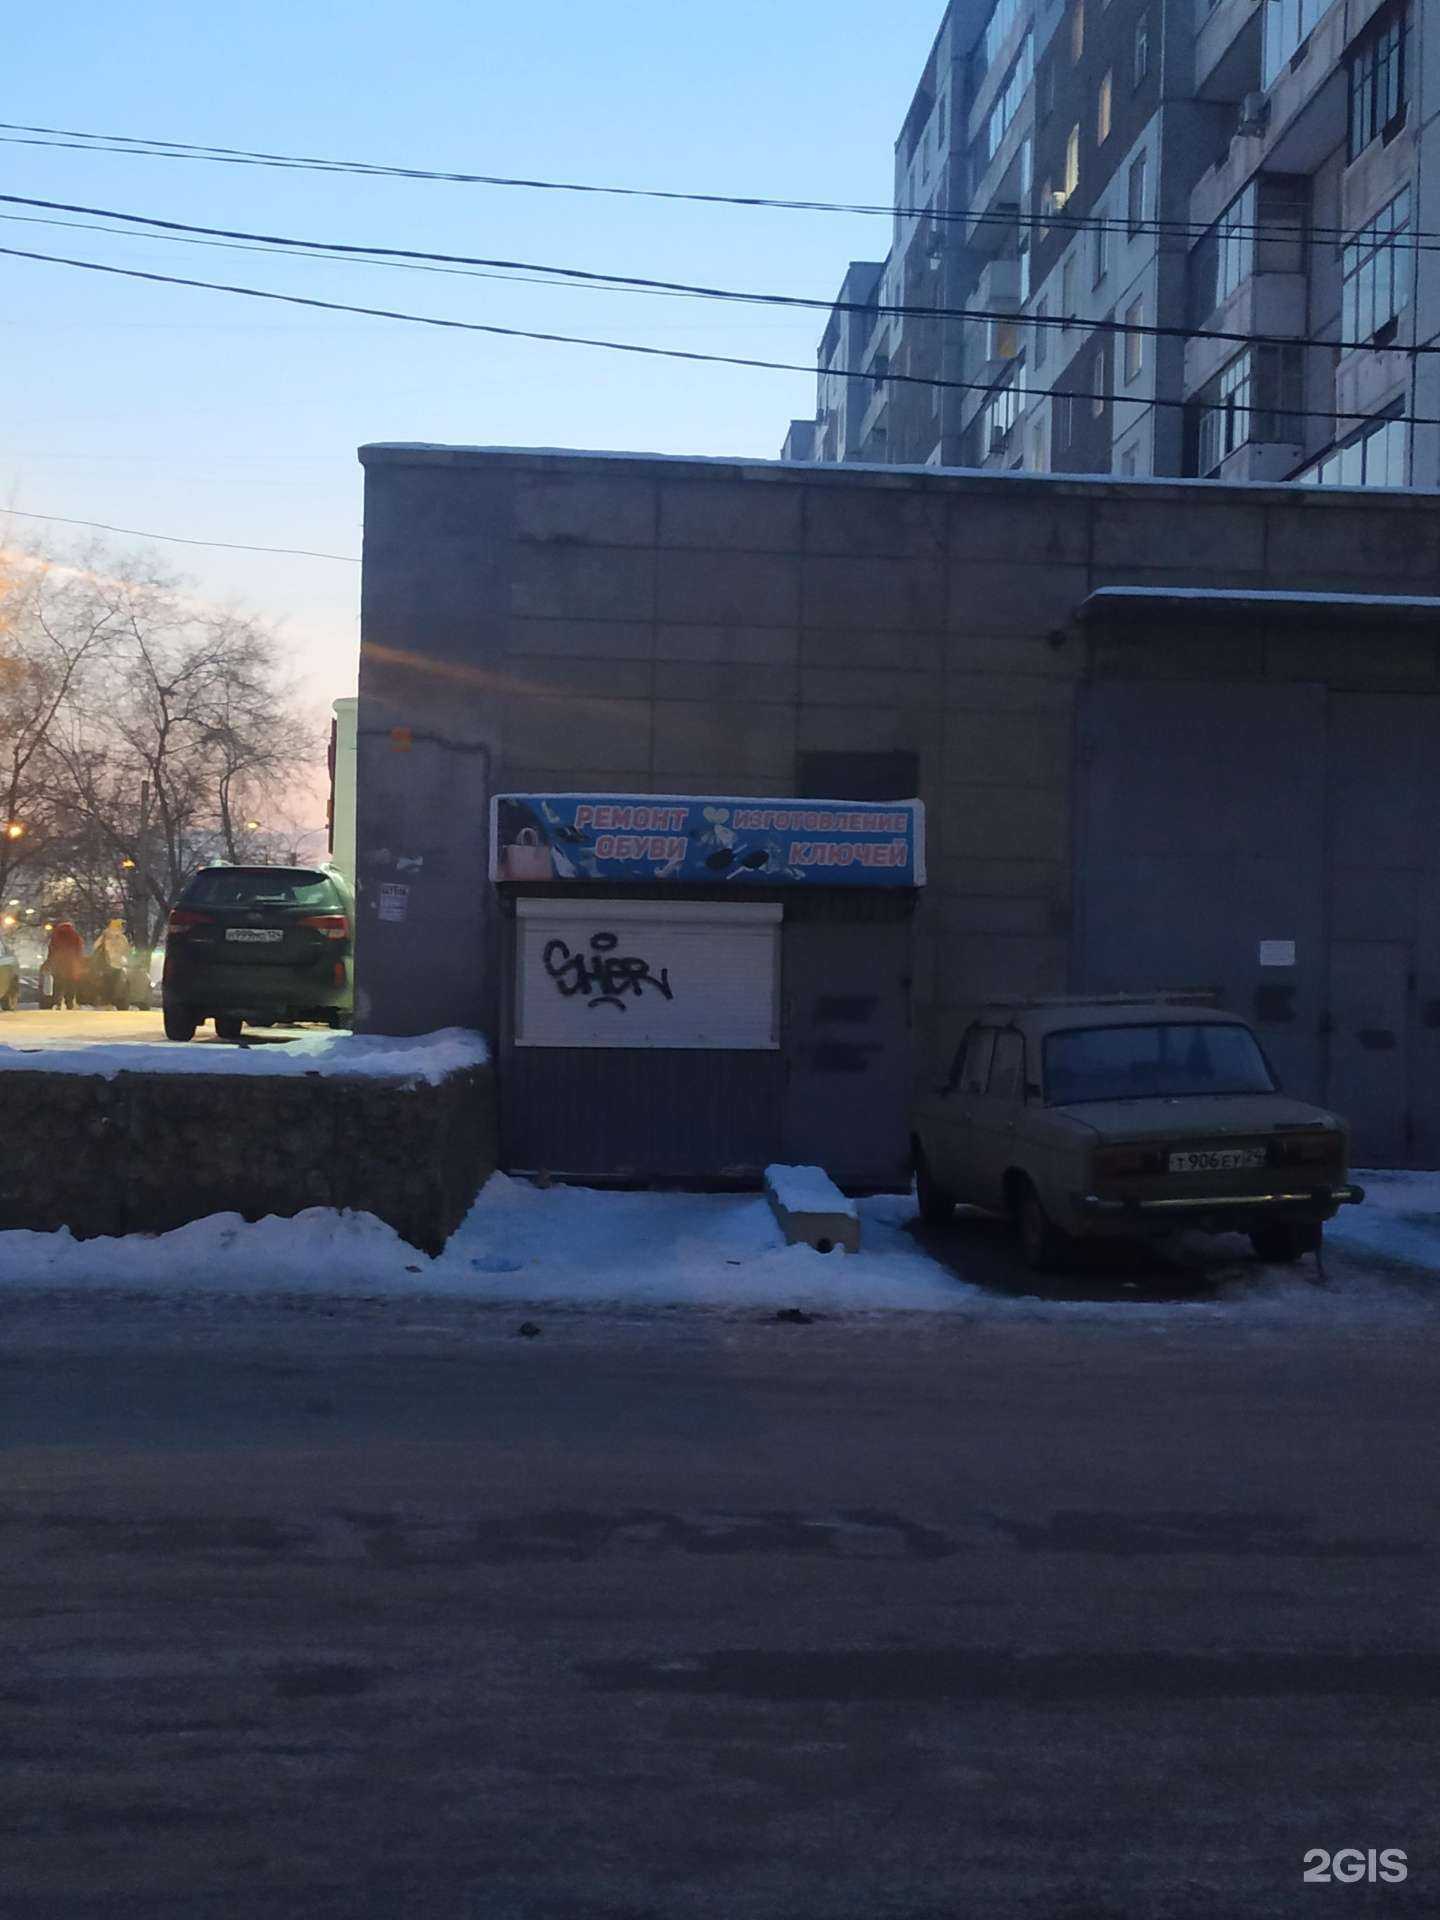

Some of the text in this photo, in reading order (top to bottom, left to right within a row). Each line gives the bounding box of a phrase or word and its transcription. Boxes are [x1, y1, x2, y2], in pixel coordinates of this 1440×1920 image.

[575, 805, 689, 831] РЕМОНТ
[732, 809, 908, 833] ИЗГОТОВЛЕНИЕ
[595, 835, 688, 860] ОБУВИ
[788, 838, 908, 867] КЛЮЧЕЙ
